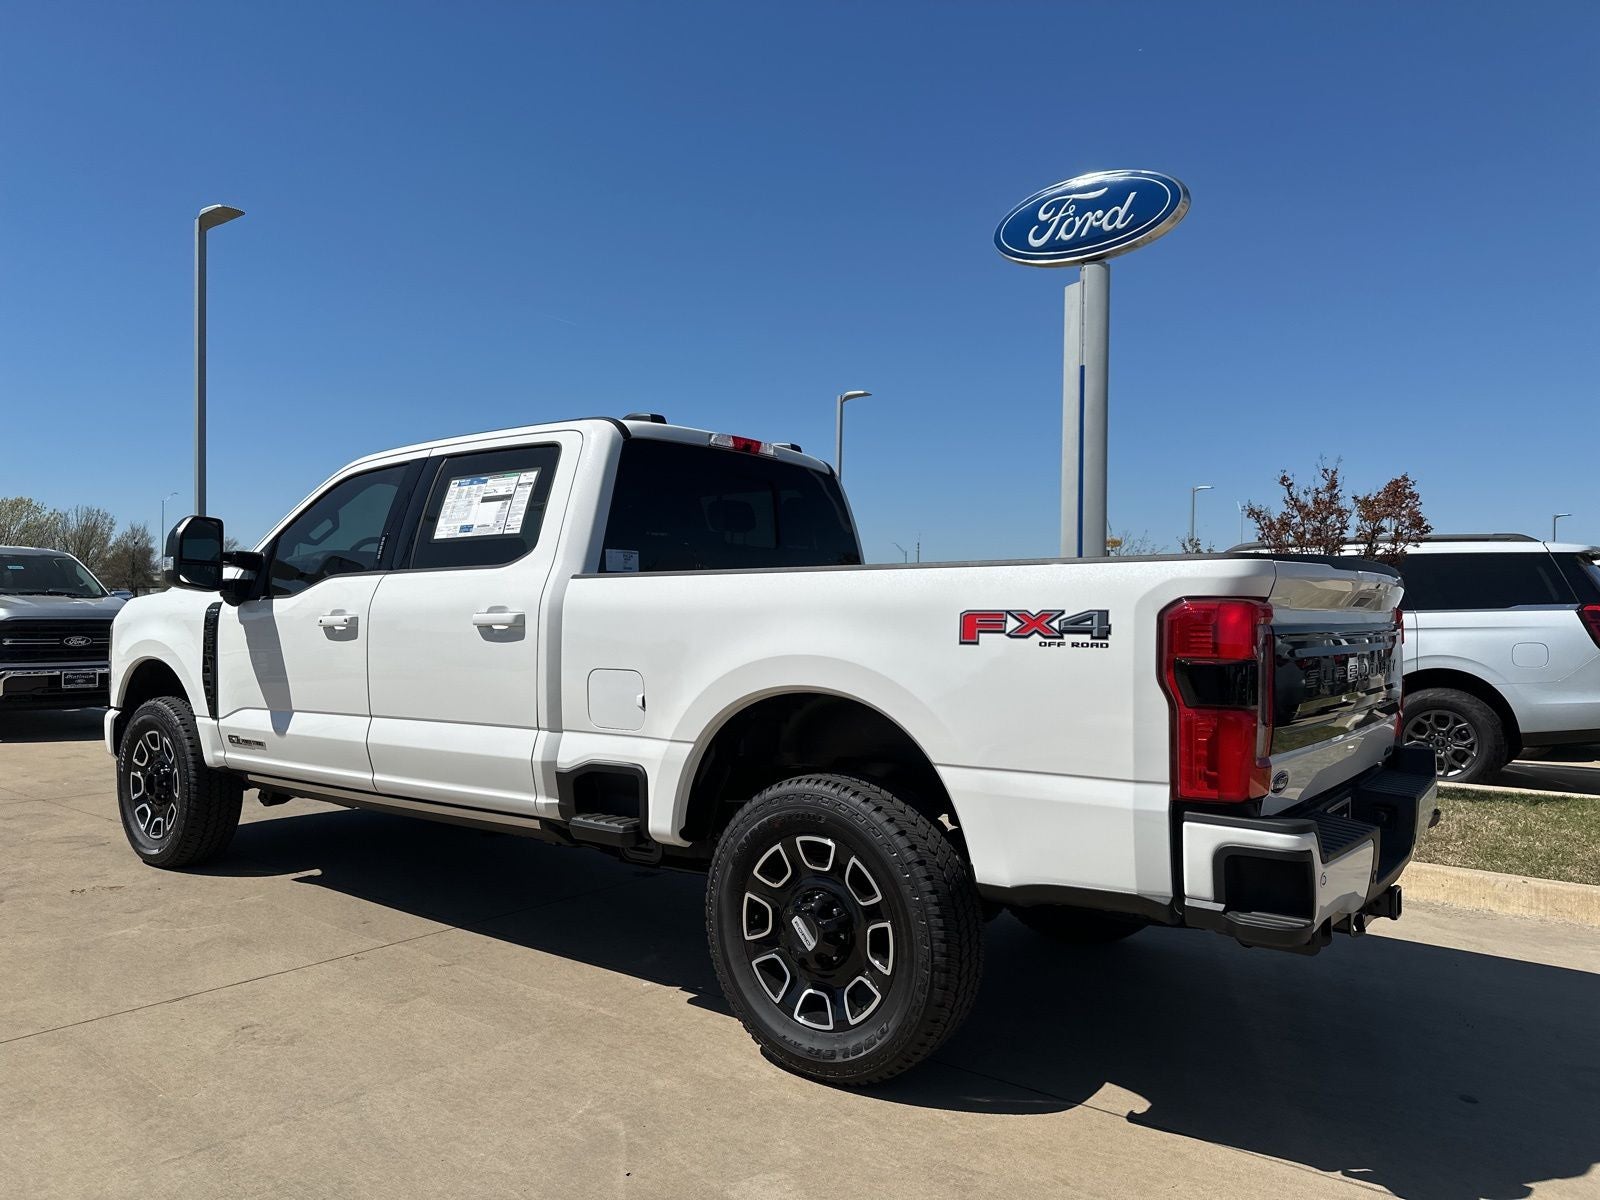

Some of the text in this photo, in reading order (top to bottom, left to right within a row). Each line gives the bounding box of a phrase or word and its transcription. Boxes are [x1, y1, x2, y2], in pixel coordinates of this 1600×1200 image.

[1028, 187, 1137, 247] Ford
[959, 609, 1112, 645] FX4
[68, 636, 87, 645] Ford
[1071, 641, 1110, 649] ROAD
